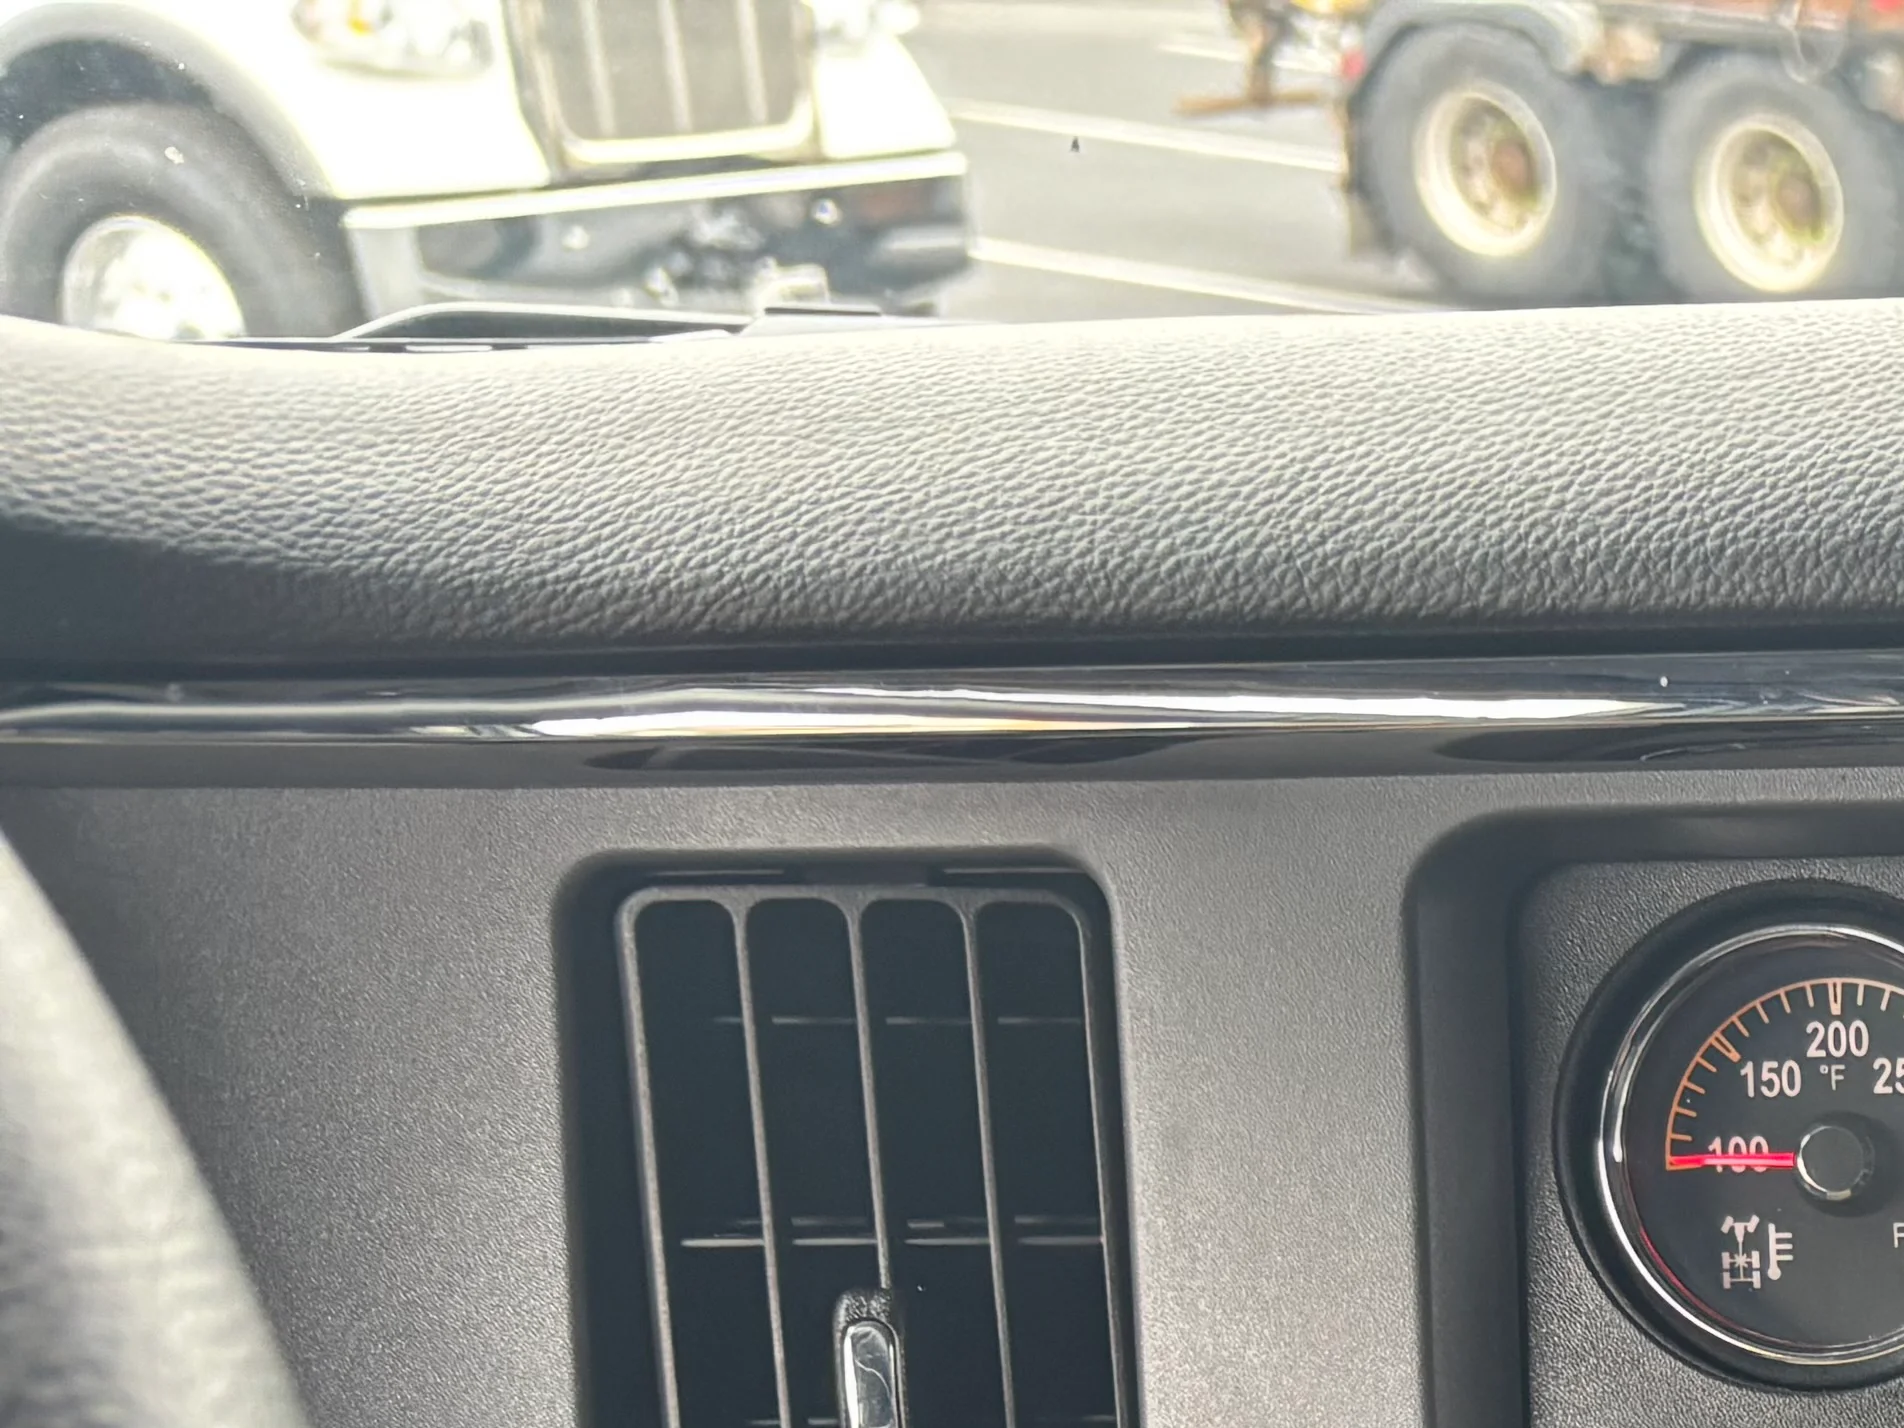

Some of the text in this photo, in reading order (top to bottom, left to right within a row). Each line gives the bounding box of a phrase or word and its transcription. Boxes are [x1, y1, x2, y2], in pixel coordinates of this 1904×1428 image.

[1806, 1021, 1868, 1058] 200
[1740, 1061, 1802, 1098] 150
[1708, 1136, 1769, 1172] 100
